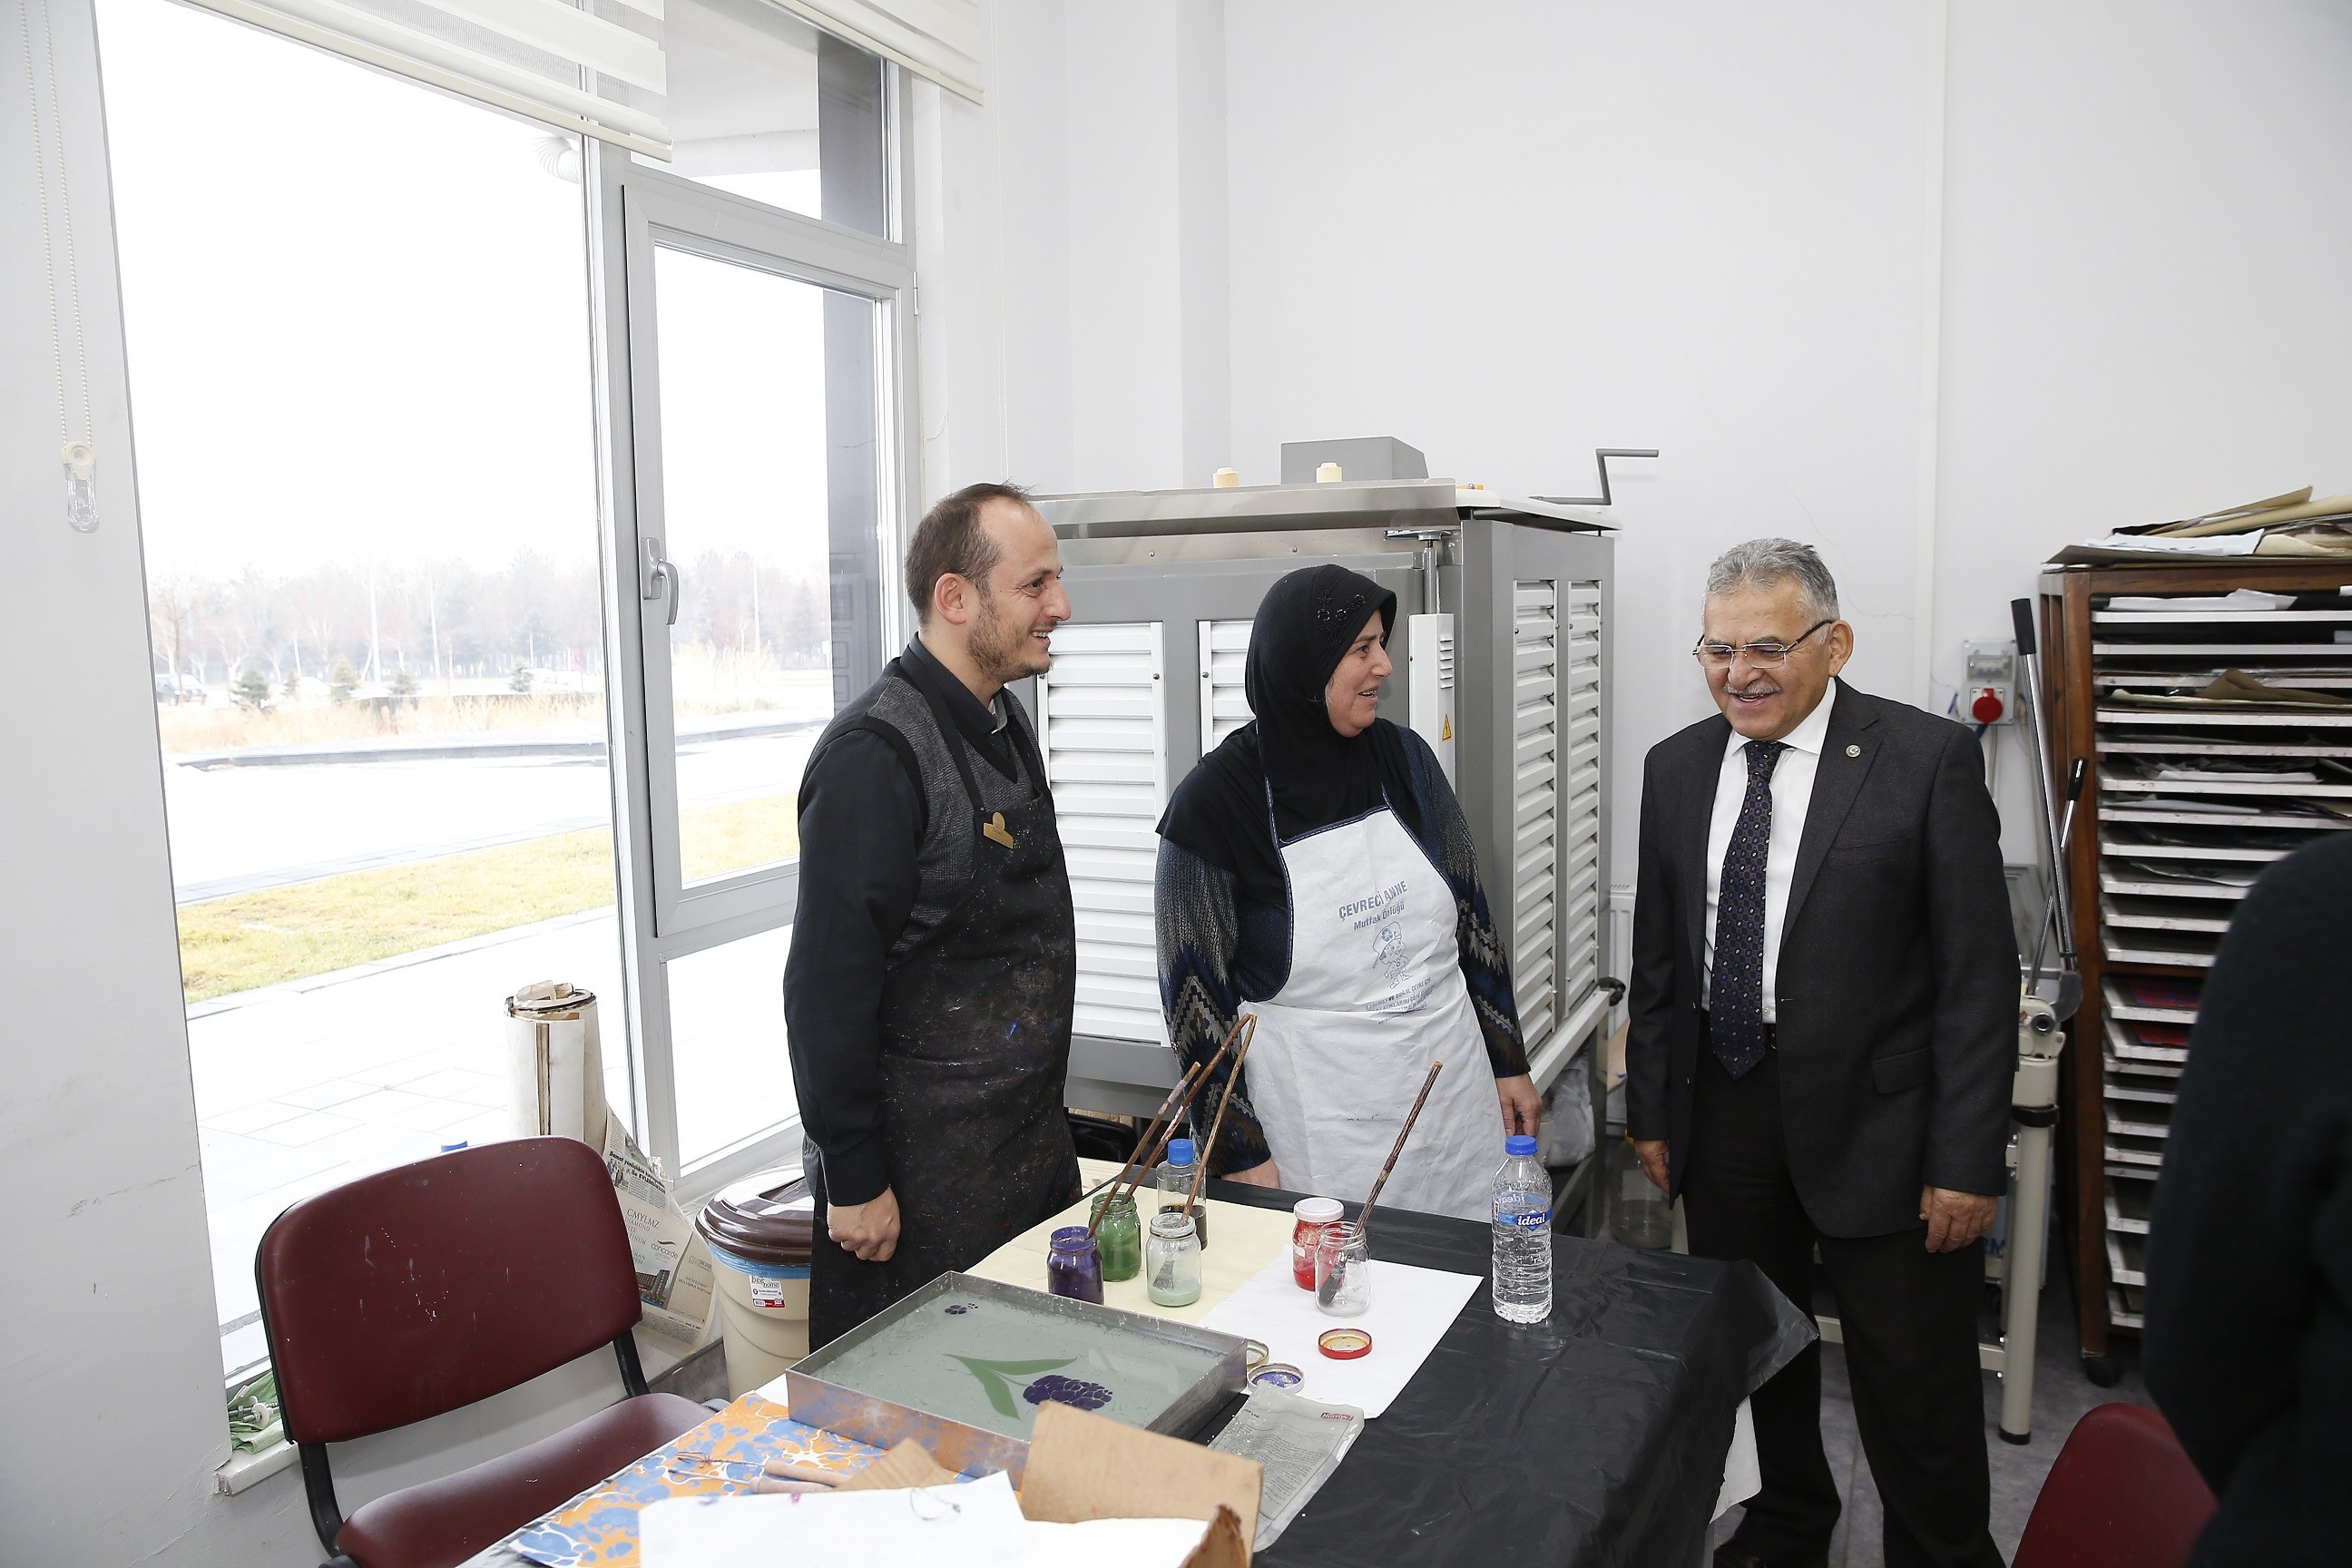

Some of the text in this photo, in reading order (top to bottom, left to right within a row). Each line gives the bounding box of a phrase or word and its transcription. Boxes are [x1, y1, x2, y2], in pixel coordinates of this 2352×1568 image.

[1338, 880, 1407, 922] ÇEVRECİ ANNE
[1354, 914, 1380, 930] Mutfak
[627, 1208, 660, 1230] CMYLMZ
[1517, 1212, 1545, 1226] ideal
[651, 1243, 679, 1259] concorde
